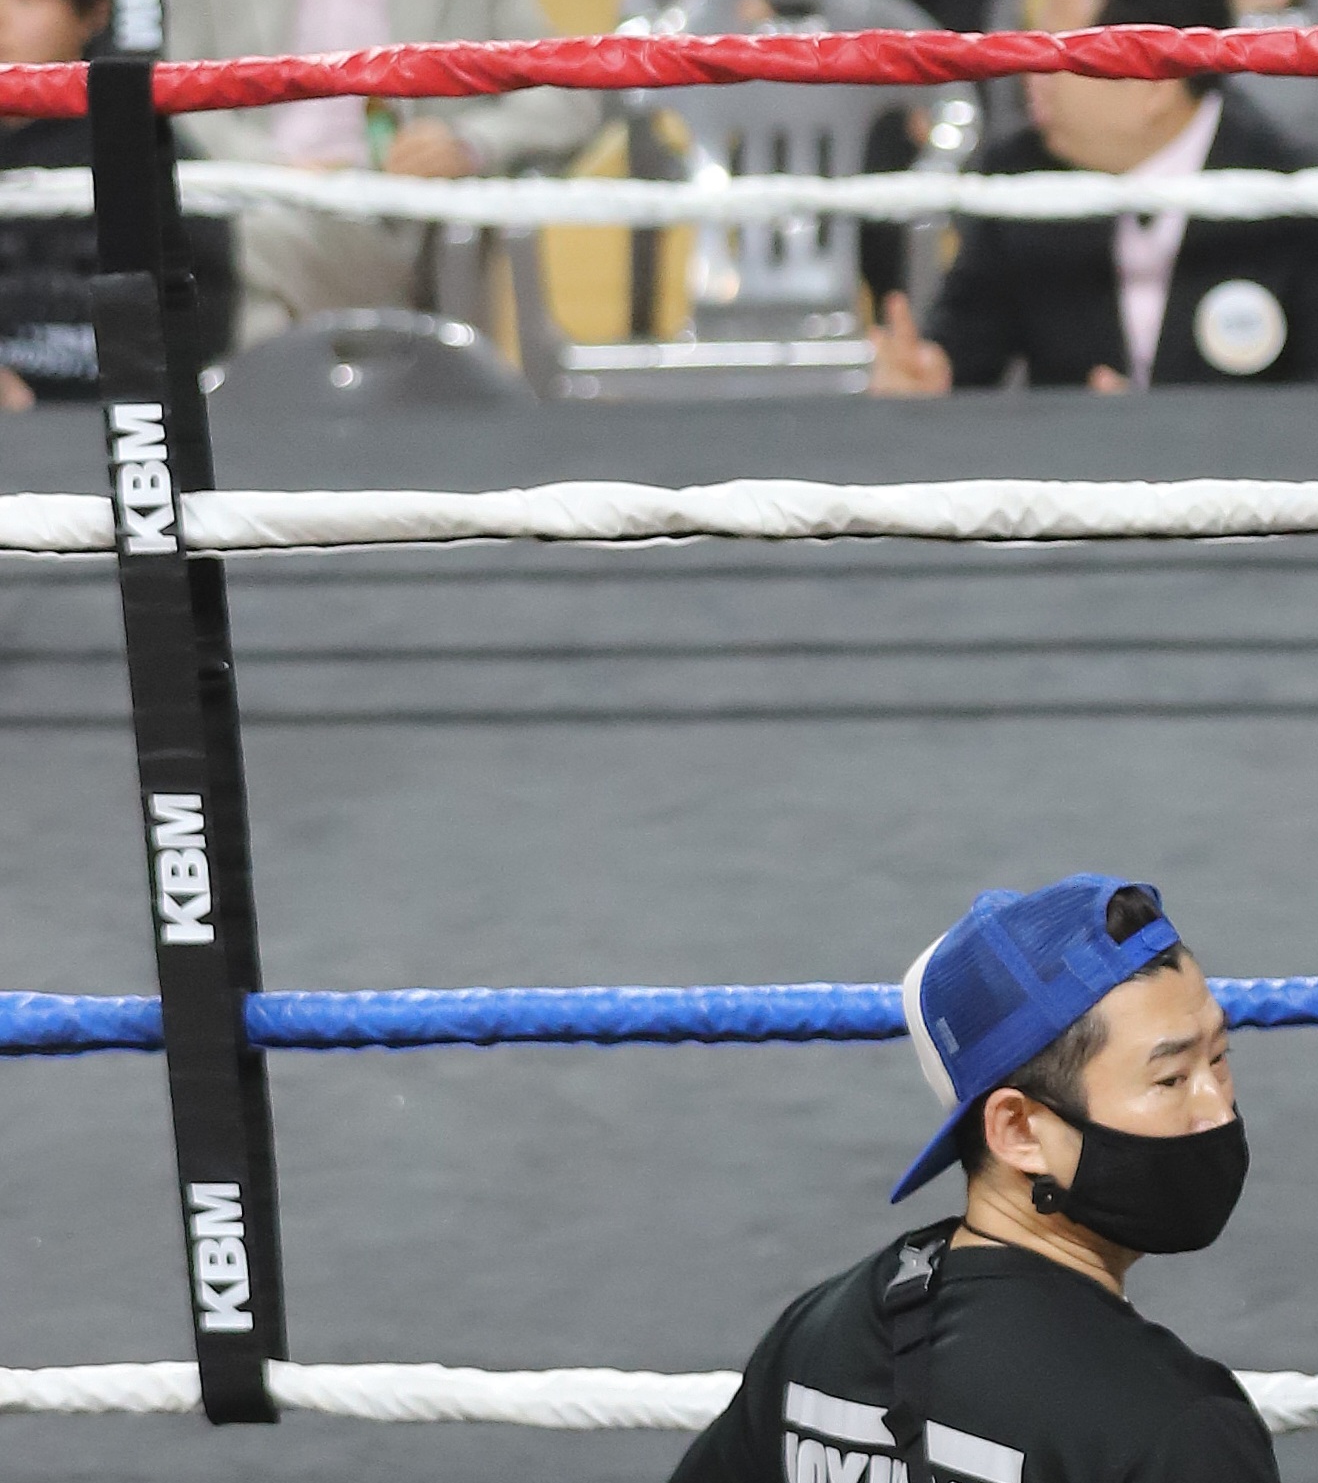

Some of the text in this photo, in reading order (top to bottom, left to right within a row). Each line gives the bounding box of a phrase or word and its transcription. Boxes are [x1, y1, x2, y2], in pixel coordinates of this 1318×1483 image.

[110, 402, 177, 556] KBM
[151, 792, 215, 945] KBM
[189, 1181, 254, 1332] KBM
